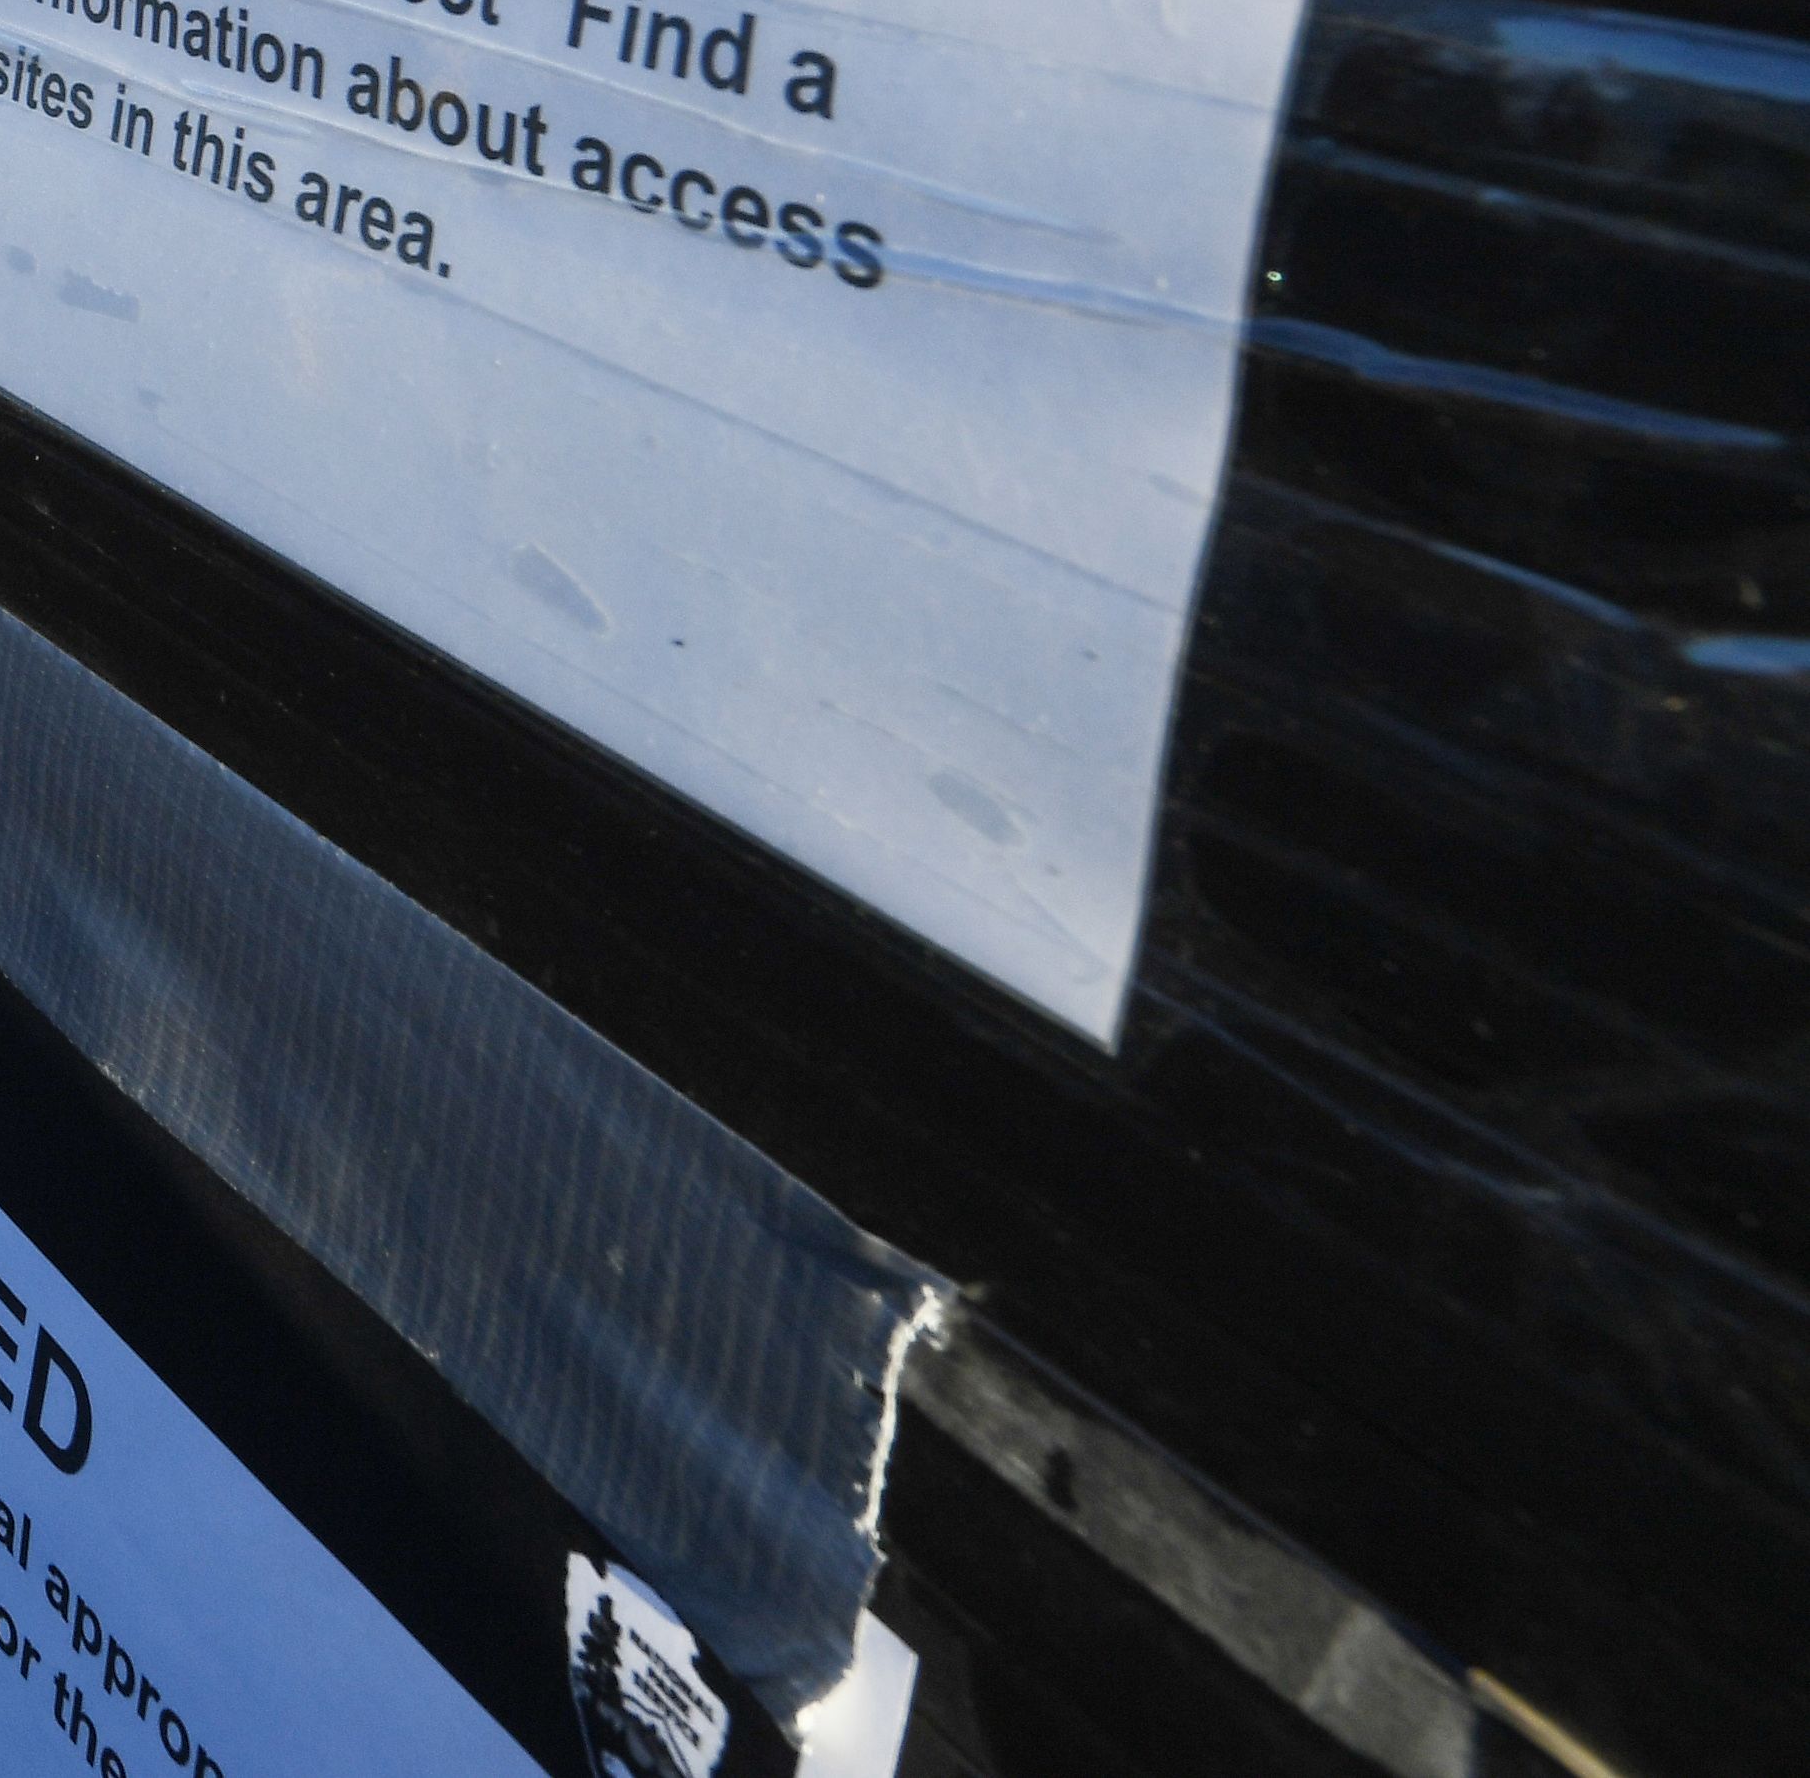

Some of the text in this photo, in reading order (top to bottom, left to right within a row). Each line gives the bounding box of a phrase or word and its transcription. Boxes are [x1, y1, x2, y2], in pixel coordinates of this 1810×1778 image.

[783, 50, 837, 119] a
[110, 82, 155, 158] in
[171, 110, 276, 204] this
[294, 169, 452, 278] area.
[346, 56, 547, 176] about
[570, 134, 886, 290] access
[53, 1671, 128, 1778] the
